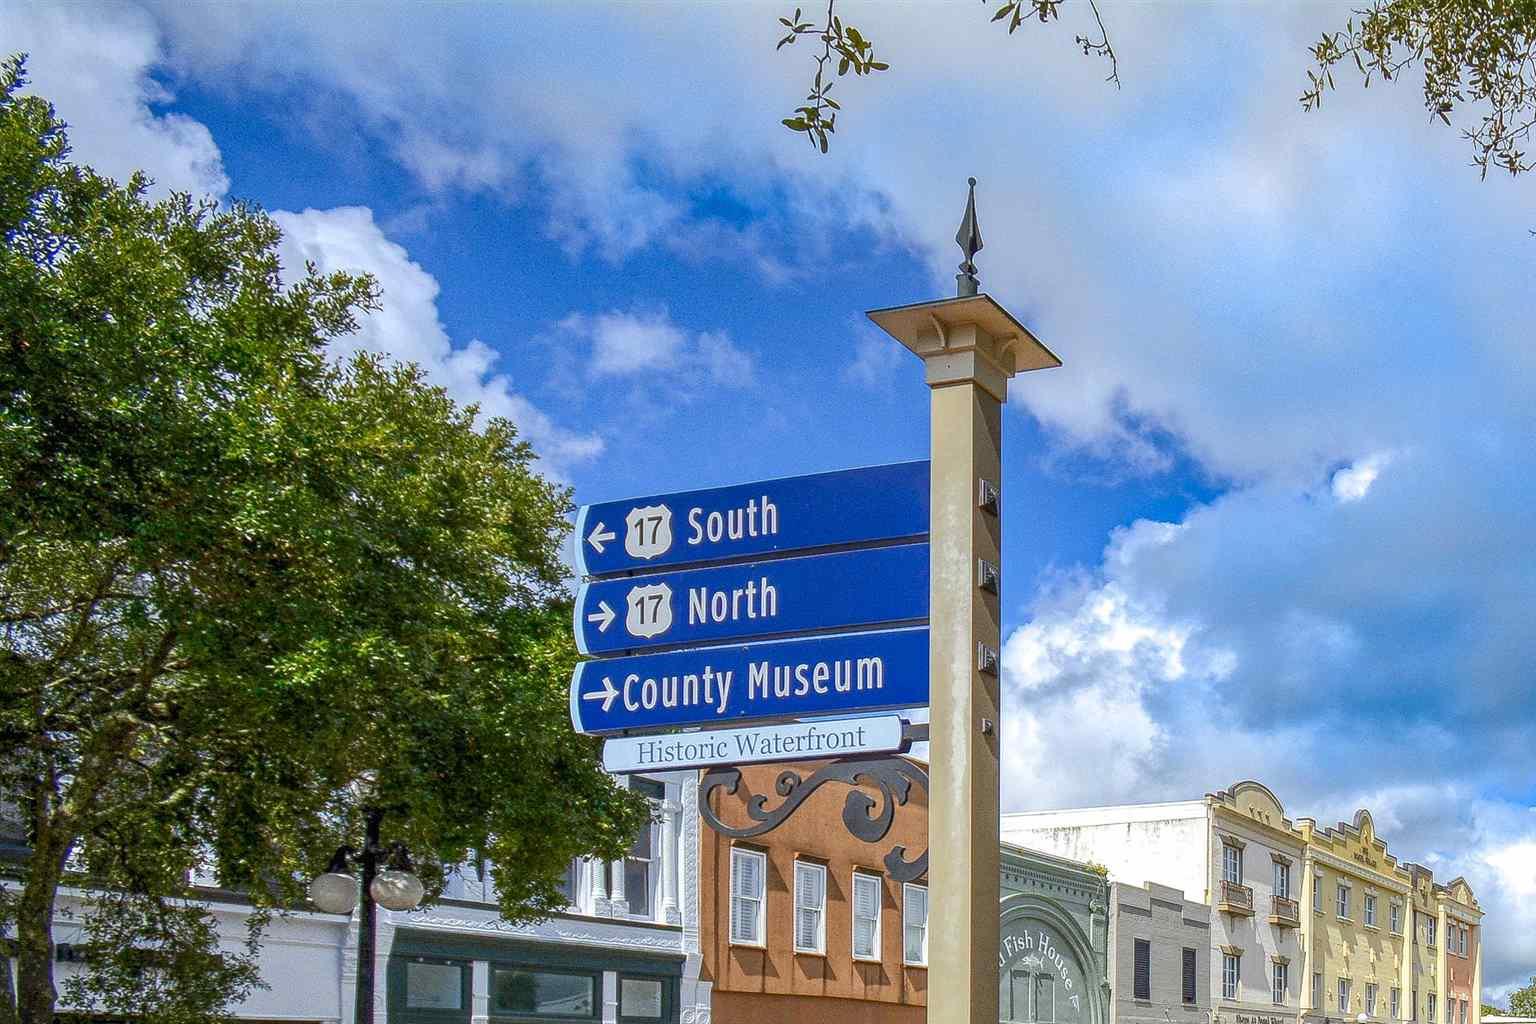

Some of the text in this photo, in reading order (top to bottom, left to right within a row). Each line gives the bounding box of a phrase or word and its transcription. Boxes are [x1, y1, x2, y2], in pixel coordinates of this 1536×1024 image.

[634, 495, 778, 547] 17 South
[634, 576, 777, 626] 17 North
[623, 656, 884, 714] County Museum
[637, 726, 866, 765] Historic Waterfront
[1003, 930, 1073, 991] Fish House
